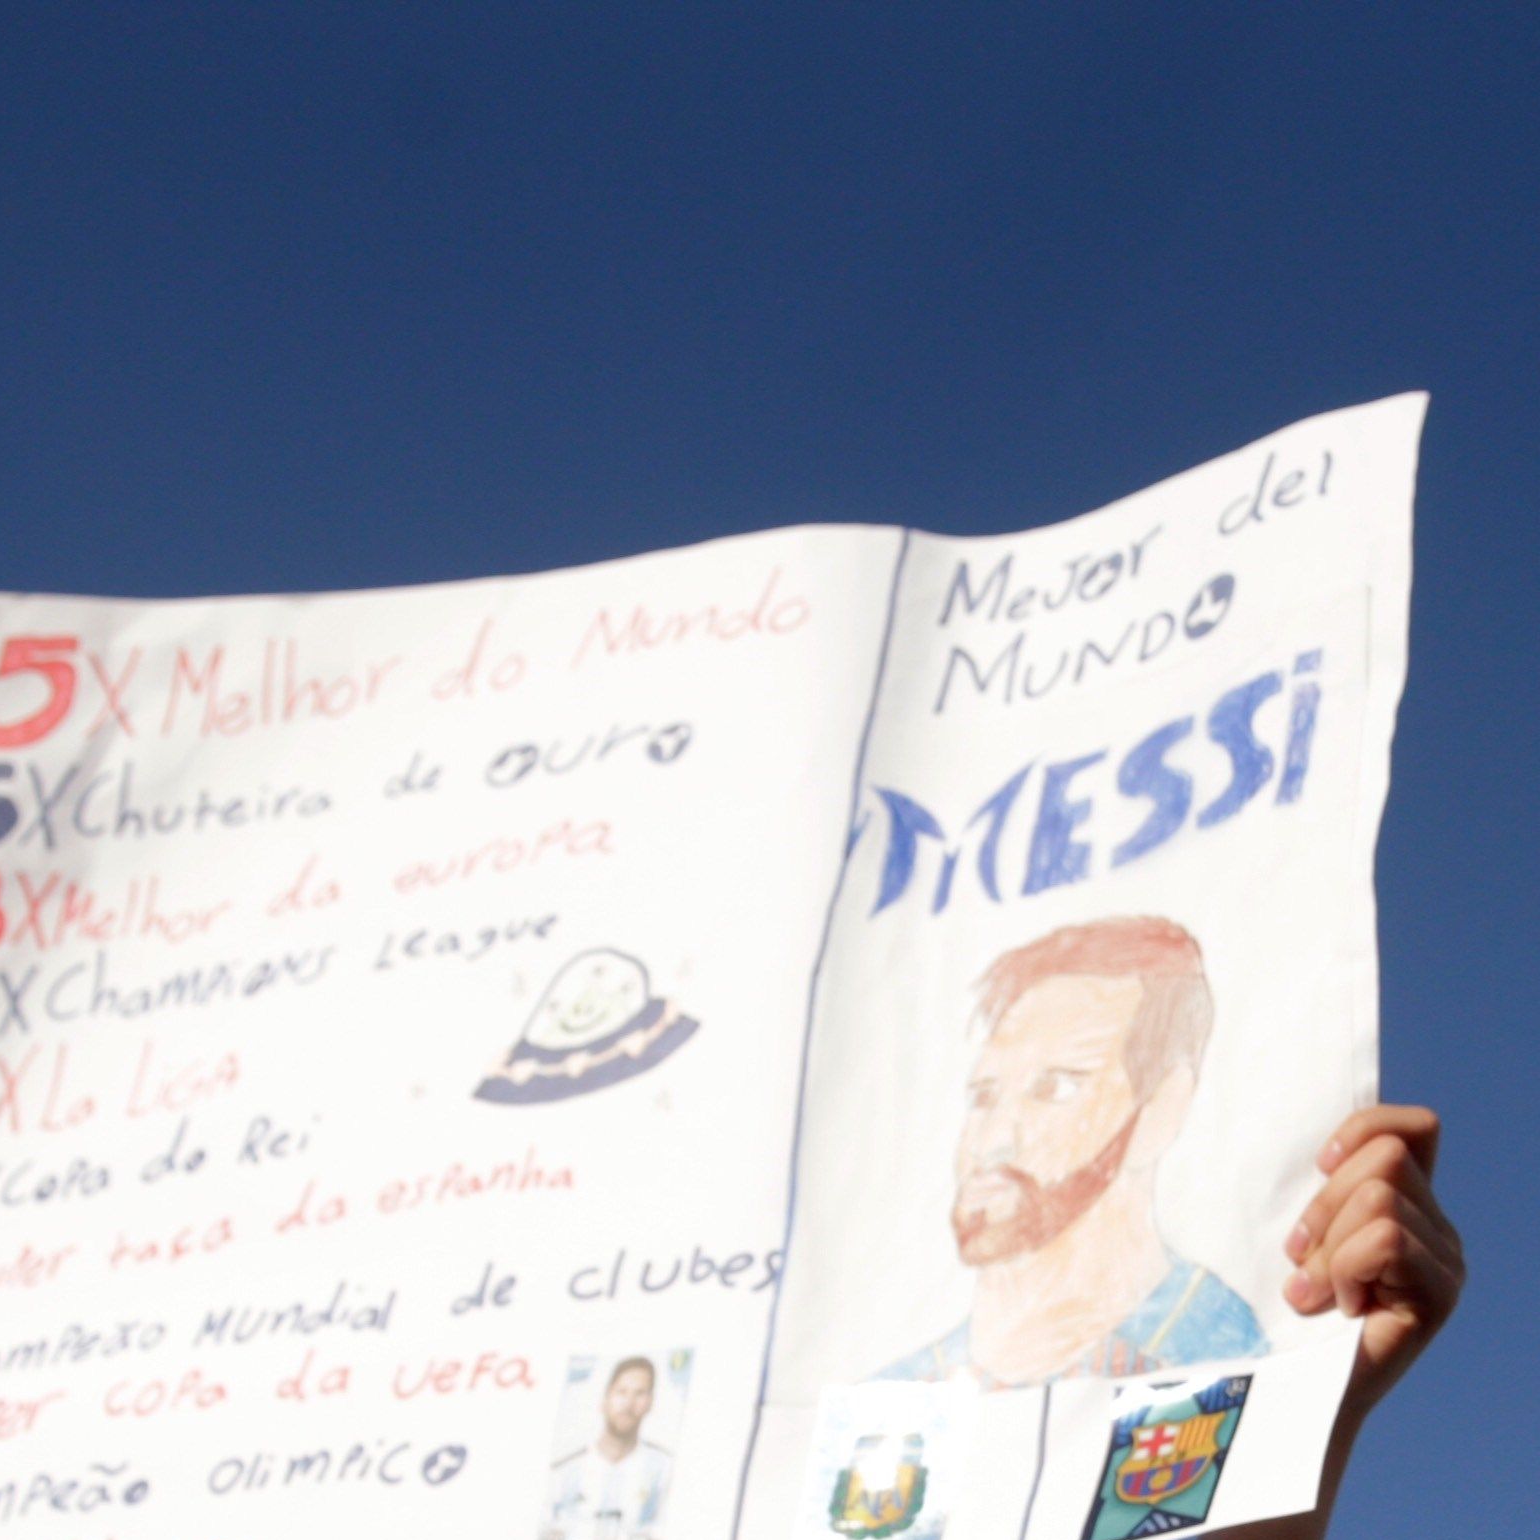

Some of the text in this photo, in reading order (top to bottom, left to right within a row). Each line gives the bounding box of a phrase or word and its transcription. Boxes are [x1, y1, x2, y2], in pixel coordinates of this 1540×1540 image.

[1217, 451, 1332, 537] del
[161, 638, 403, 739] Melhor
[431, 615, 527, 701] do
[571, 564, 812, 671] Mundo
[383, 749, 444, 800] de
[266, 852, 341, 917] da
[139, 1114, 207, 1184] do
[275, 1178, 346, 1234] da
[451, 1261, 517, 1316] de
[275, 1348, 350, 1402] da
